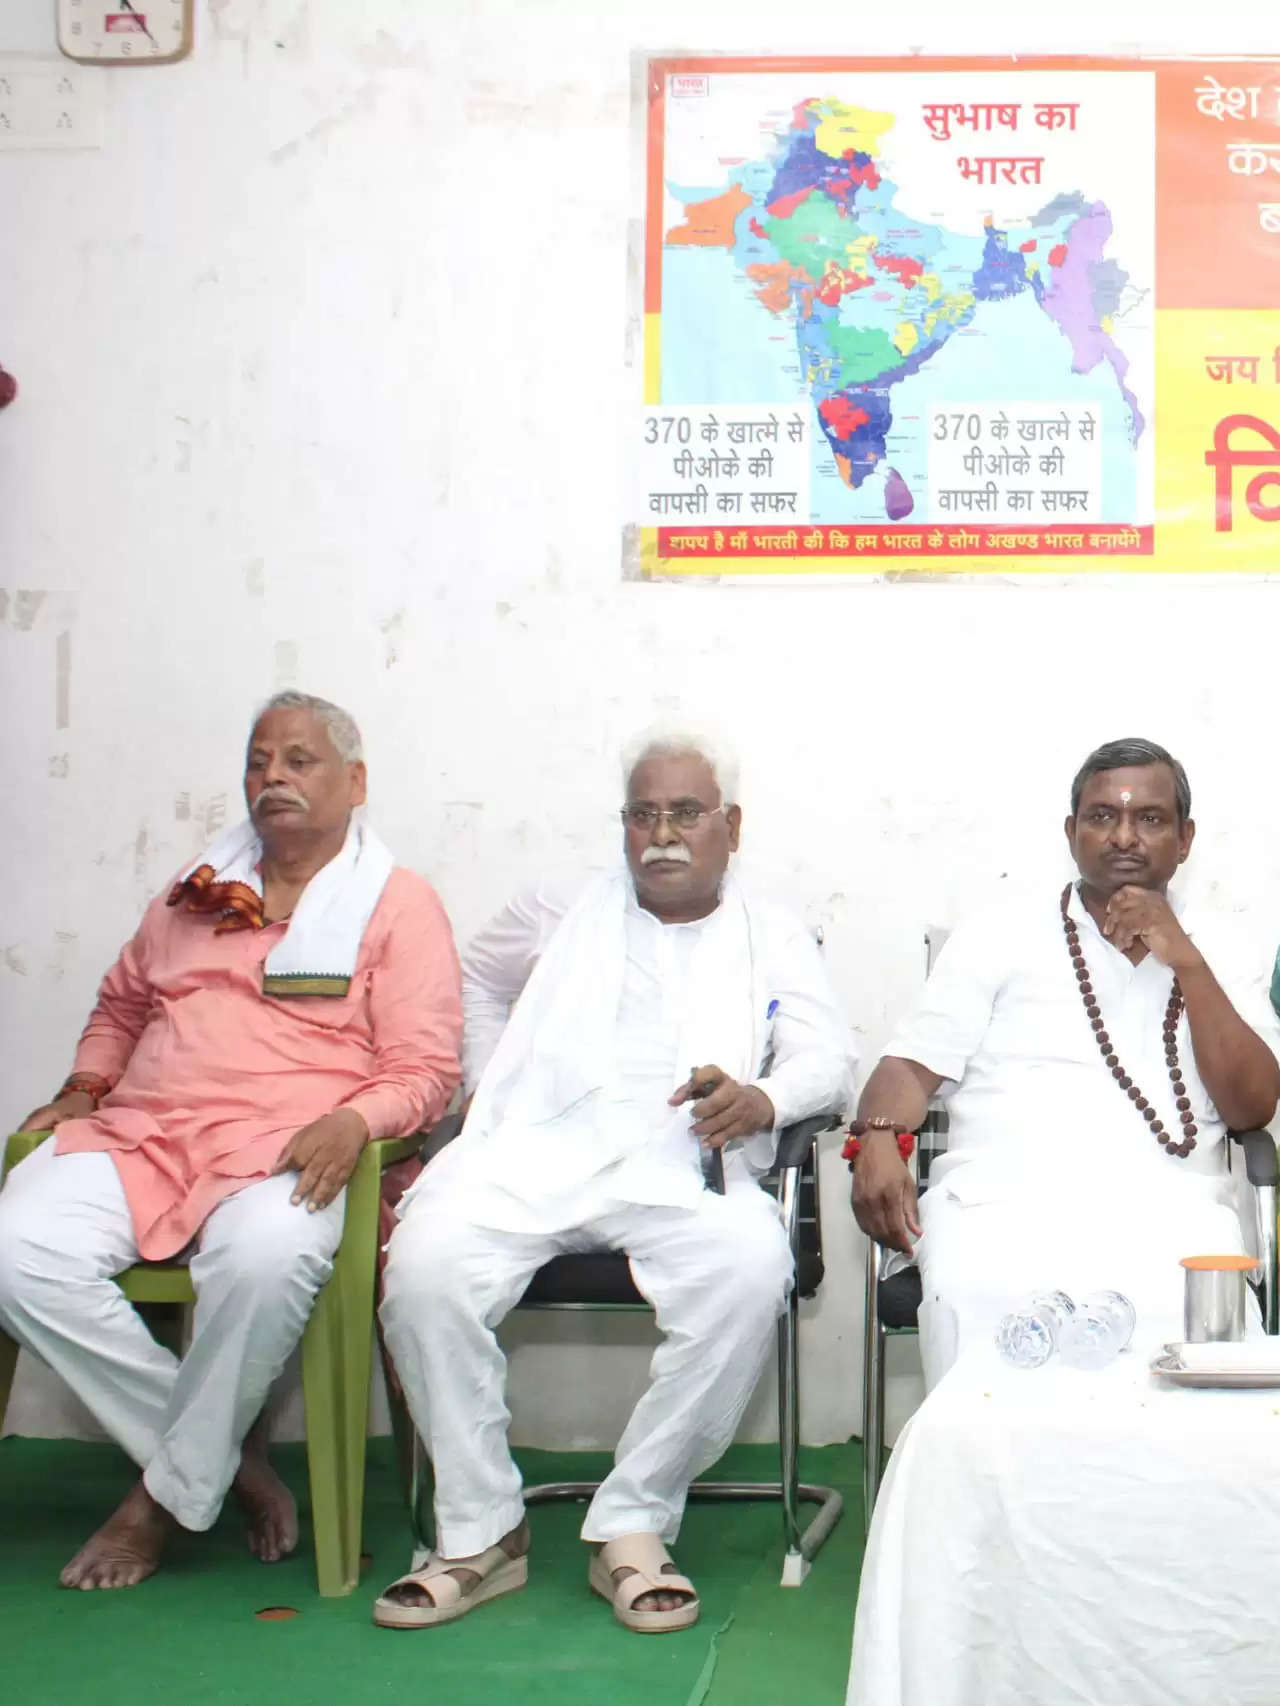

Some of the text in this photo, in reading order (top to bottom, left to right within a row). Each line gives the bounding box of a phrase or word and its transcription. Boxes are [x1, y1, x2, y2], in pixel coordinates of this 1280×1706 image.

[1196, 76, 1261, 120] देश
[922, 103, 1080, 140] सुभाष का
[957, 156, 1044, 185] भारत
[1206, 356, 1260, 384] जय
[645, 412, 804, 445] 370 के खात्मे से
[934, 411, 1095, 442] 370 के खात्मे से
[673, 449, 773, 478] पीओके की
[963, 446, 1064, 476] पीओके की
[650, 485, 797, 514] वापसी का सफर
[939, 482, 1088, 512] वापसी का सफर
[713, 531, 724, 551] है
[753, 532, 797, 549] भारती
[803, 531, 824, 549] की
[829, 531, 849, 549] कि
[855, 534, 877, 549] हम
[883, 534, 922, 549] भारत
[928, 529, 944, 548] के
[949, 529, 980, 548] लोग
[986, 533, 1039, 548] अखण्ड
[1044, 533, 1083, 548] भारत
